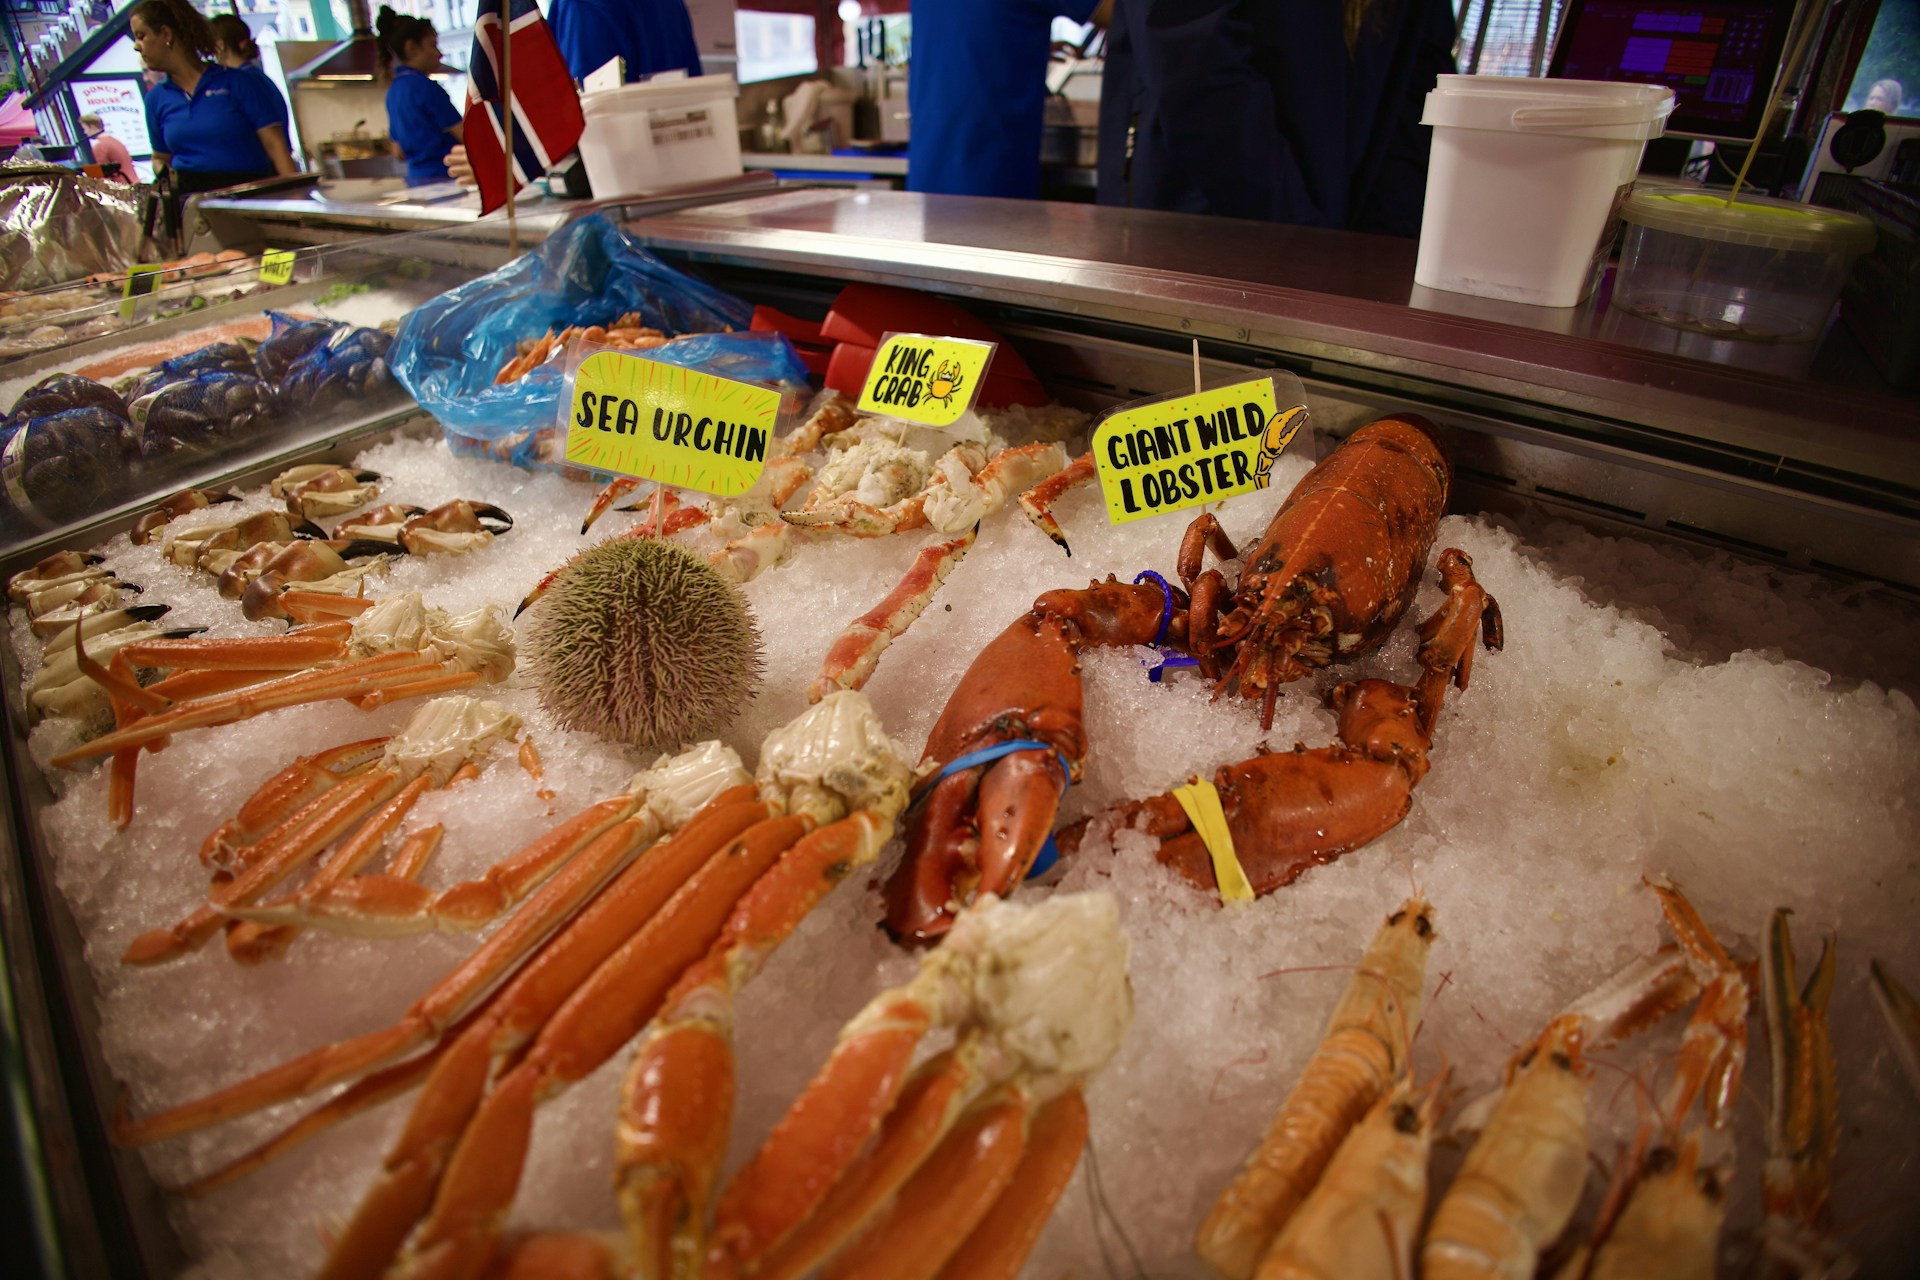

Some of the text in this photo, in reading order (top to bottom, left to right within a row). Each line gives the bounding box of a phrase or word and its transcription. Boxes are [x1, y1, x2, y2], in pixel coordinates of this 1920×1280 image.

[82, 85, 118, 97] DONUT
[86, 97, 120, 105] HOUSE
[884, 344, 934, 379] KING
[872, 375, 923, 408] CRAB
[576, 391, 767, 463] SEA URCHIN
[1107, 402, 1265, 470] GIANT WILD
[1120, 450, 1253, 514] LOBSTER
